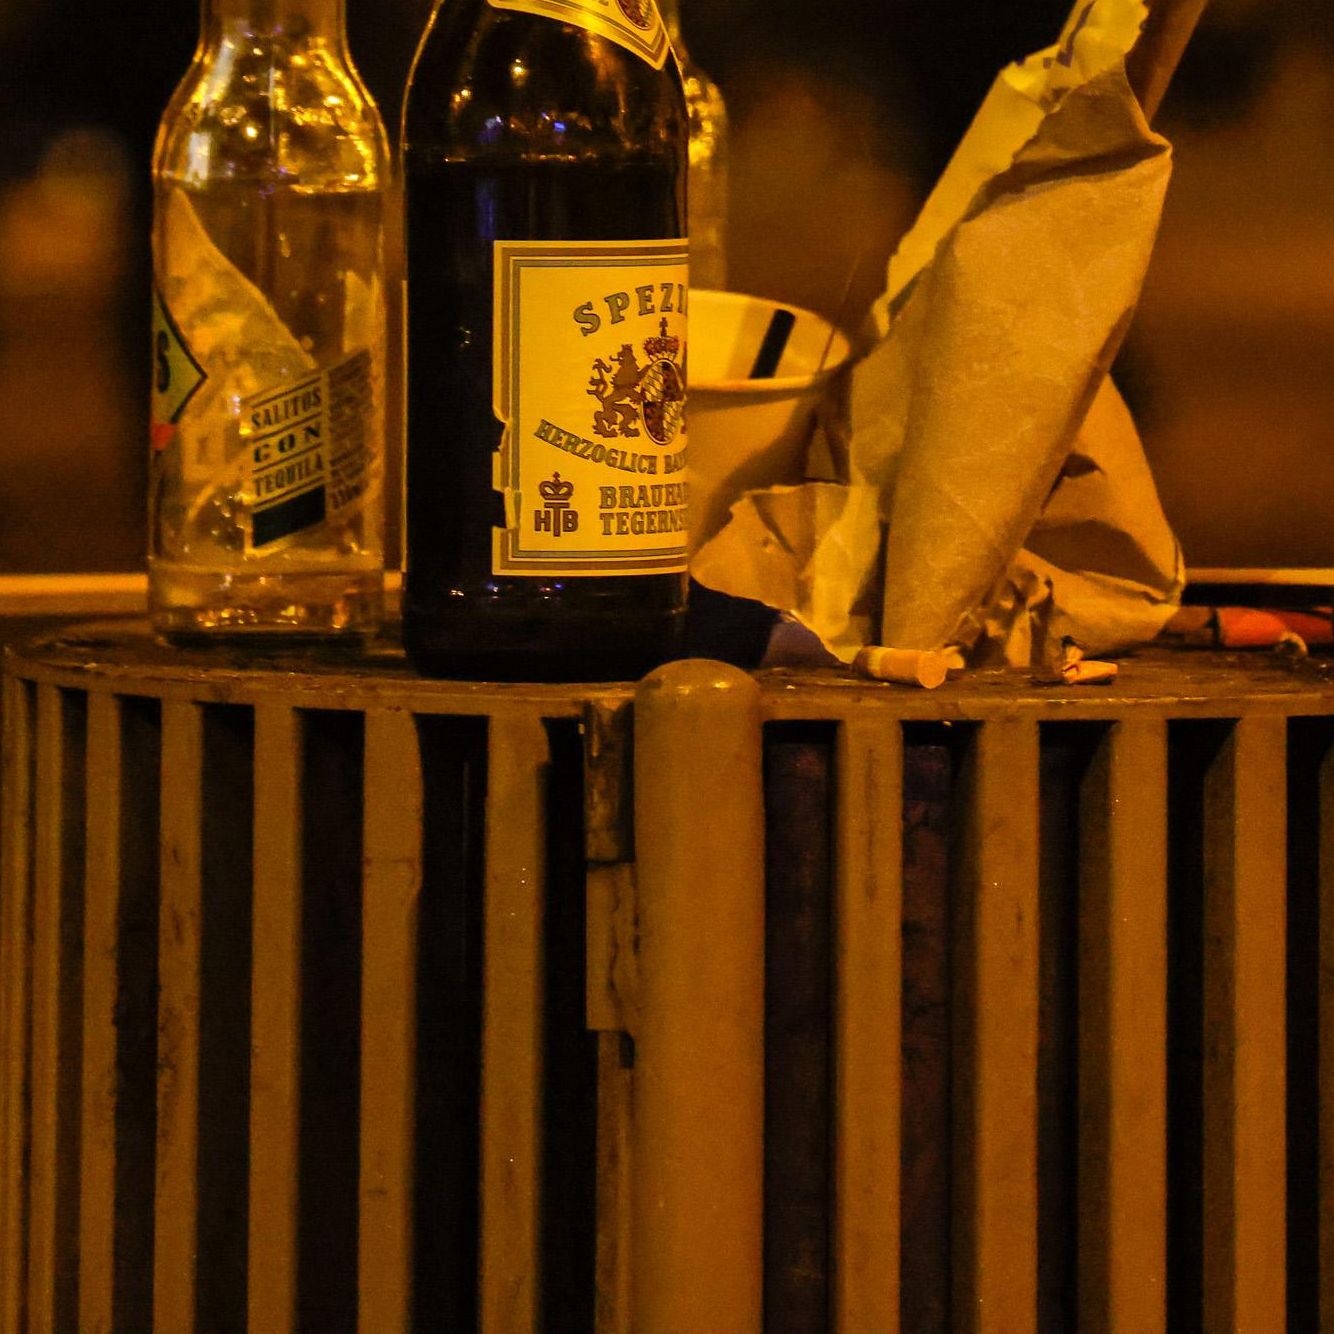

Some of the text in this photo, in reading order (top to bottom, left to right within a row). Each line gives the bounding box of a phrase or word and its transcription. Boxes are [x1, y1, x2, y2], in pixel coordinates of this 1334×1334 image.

[251, 386, 322, 429] SALITOS
[253, 422, 321, 463] CON
[533, 418, 658, 476] HERZOGLICH
